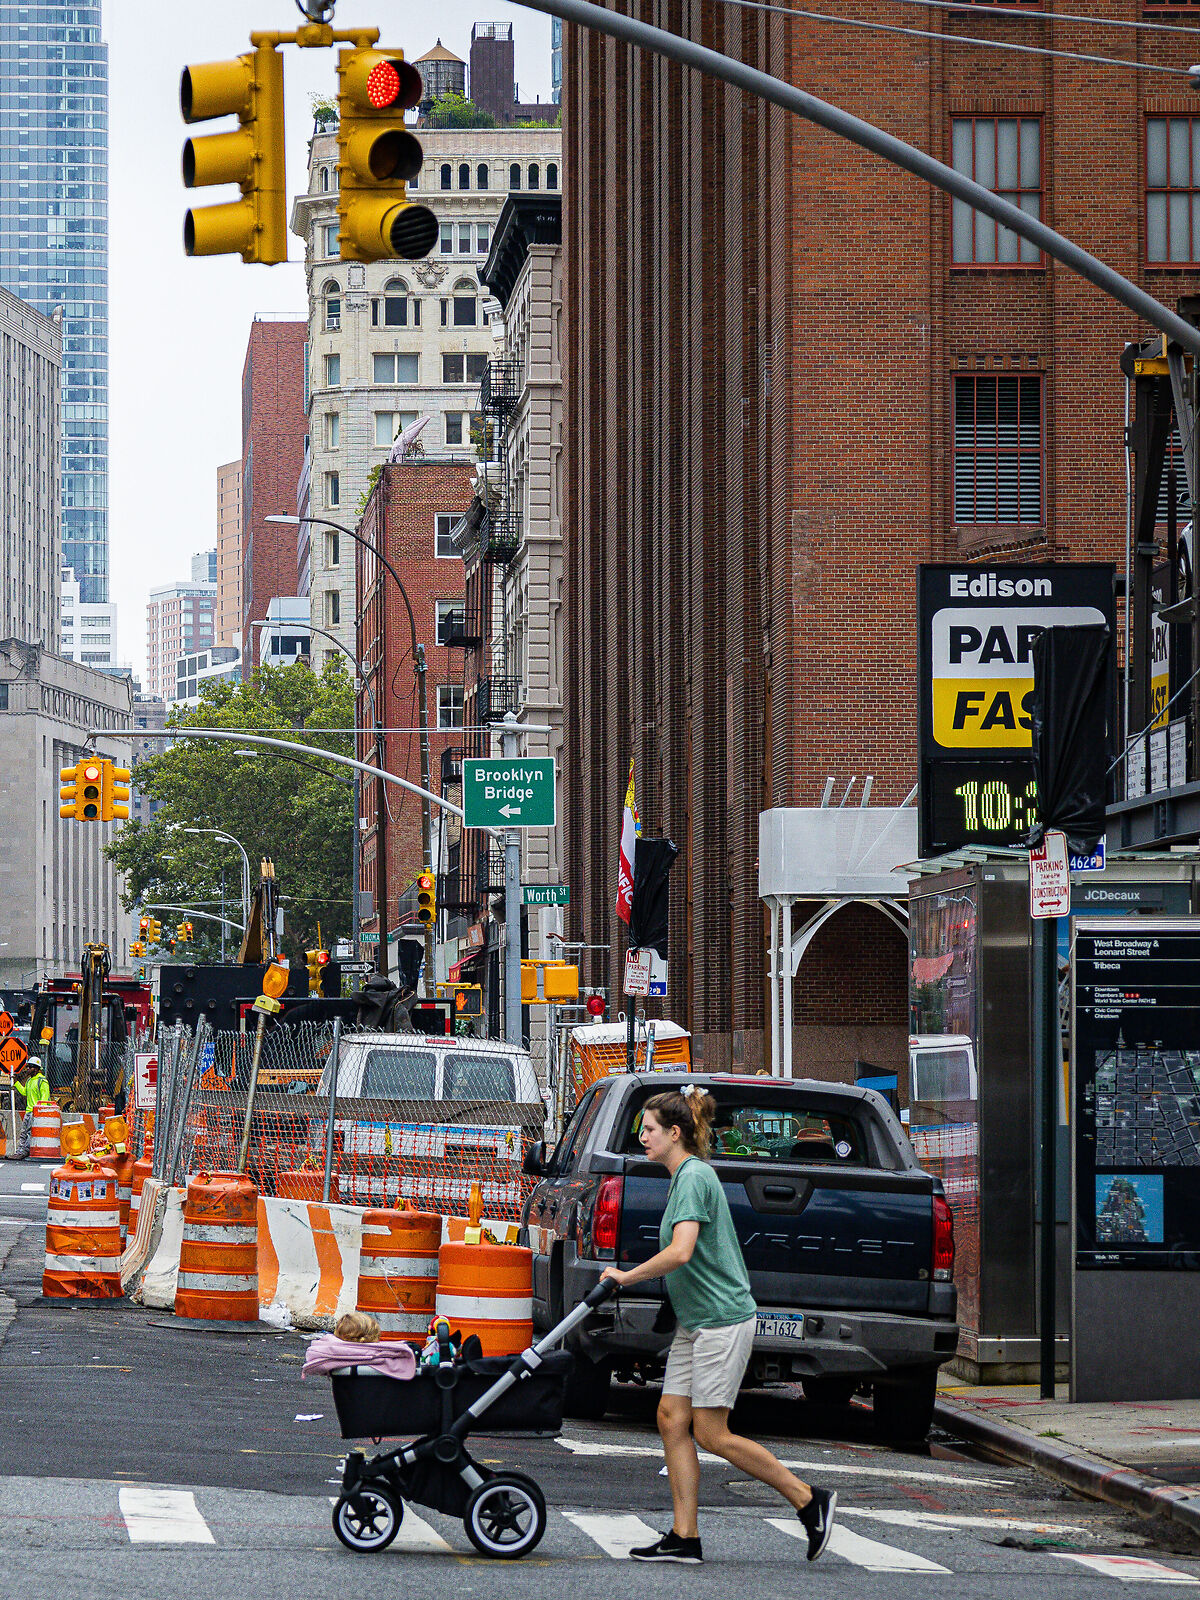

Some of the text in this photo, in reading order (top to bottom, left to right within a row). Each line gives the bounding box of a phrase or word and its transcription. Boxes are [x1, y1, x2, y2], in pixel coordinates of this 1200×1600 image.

[950, 573, 1053, 597] Edison
[949, 625, 1044, 664] PAR
[952, 690, 1036, 730] FAS
[475, 769, 543, 783] Brooklyn
[484, 786, 534, 802] Bridge
[1036, 861, 1064, 872] PARKING
[527, 888, 566, 902] Worth St
[1034, 886, 1068, 899] CONSTRUCTION
[1085, 890, 1140, 900] JCDecaux
[1114, 940, 1152, 949] Broadway
[0, 1049, 22, 1062] SLOW
